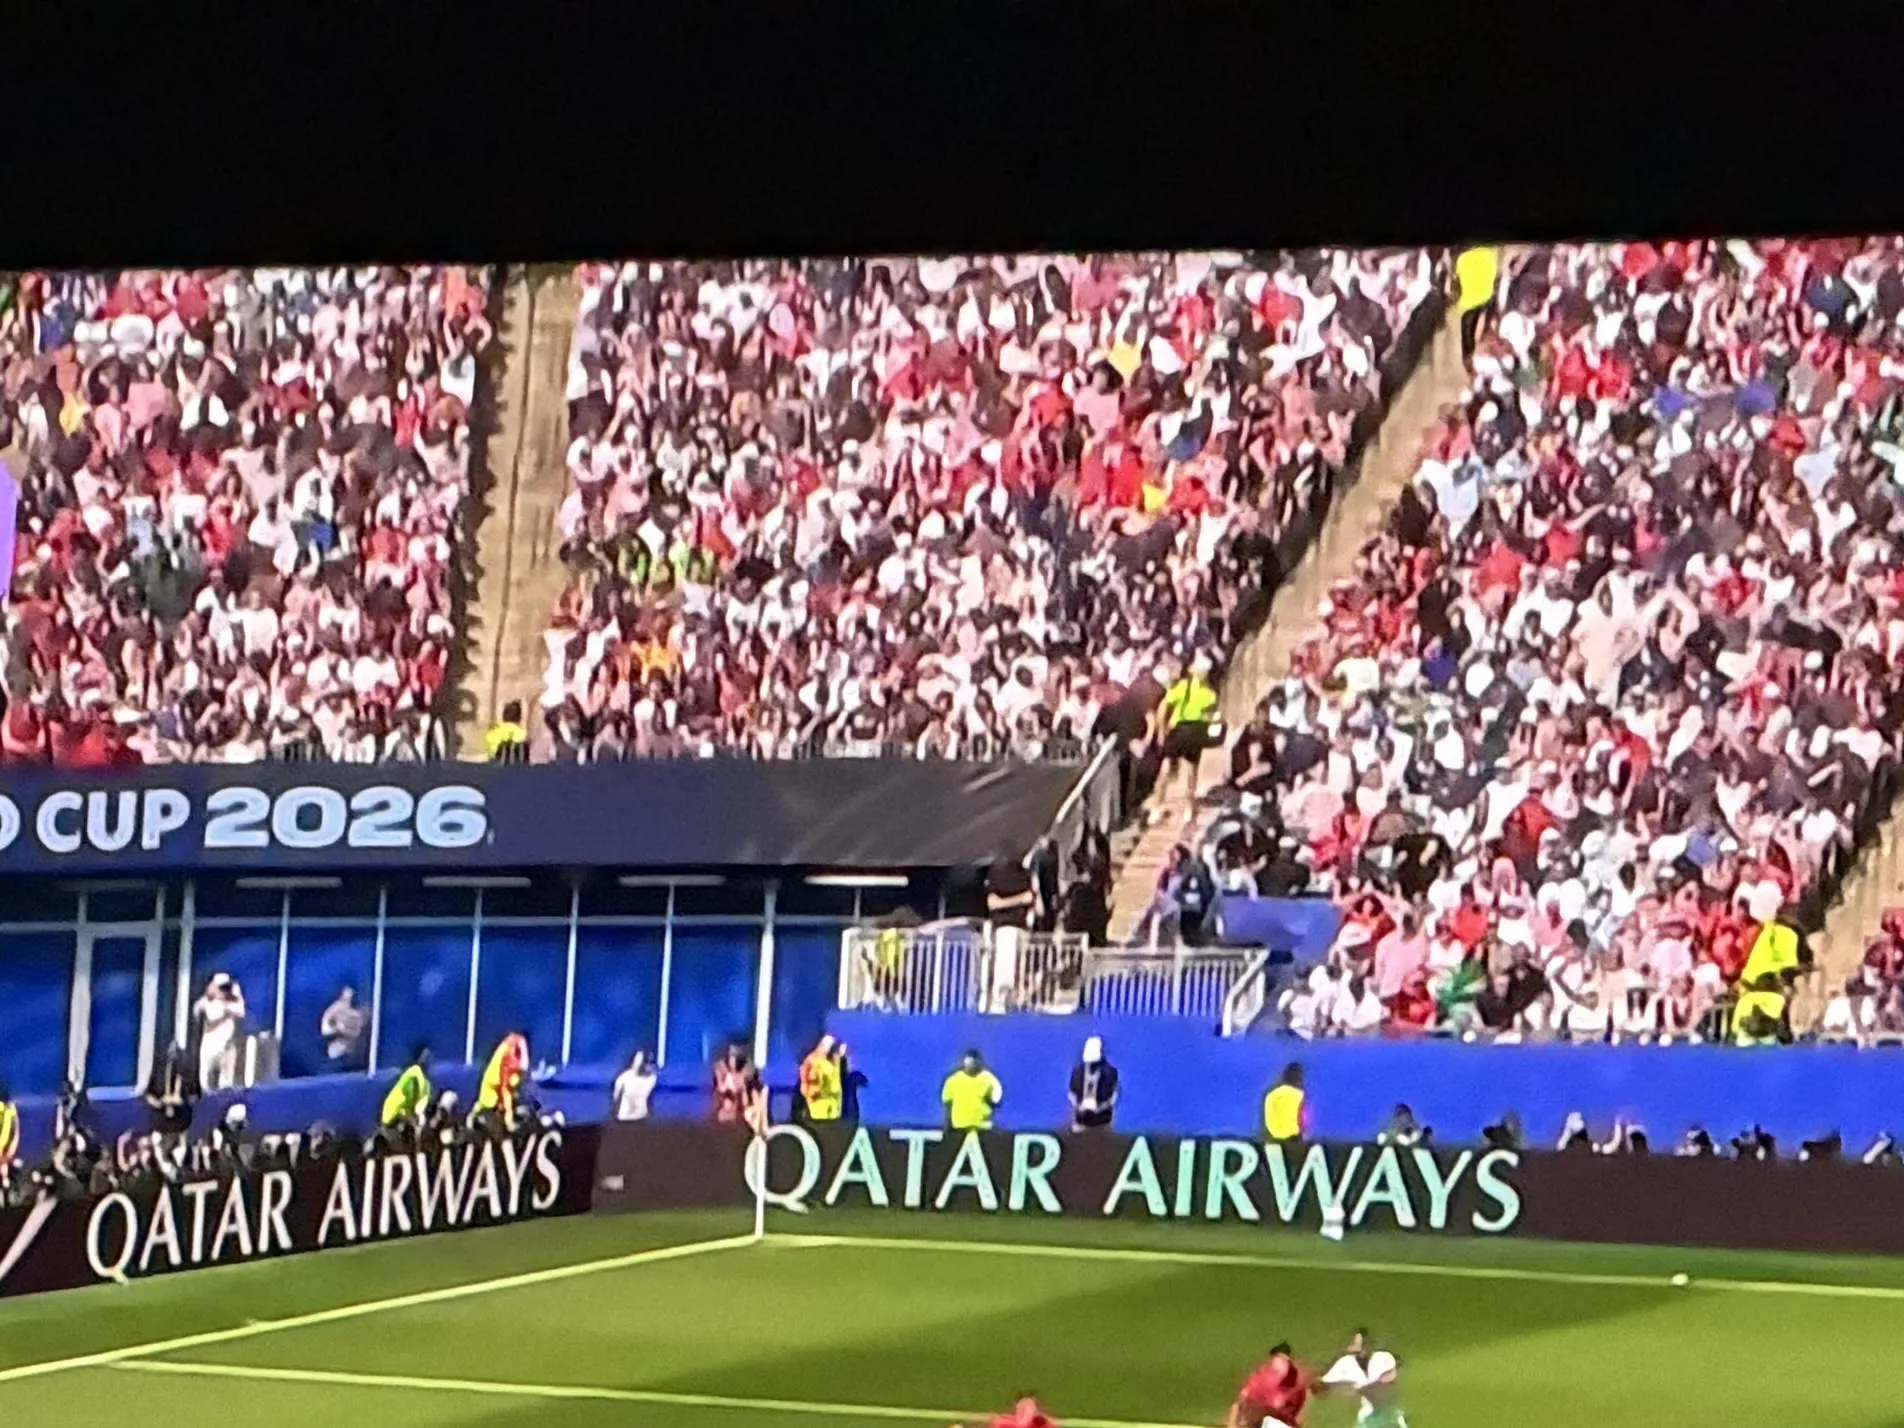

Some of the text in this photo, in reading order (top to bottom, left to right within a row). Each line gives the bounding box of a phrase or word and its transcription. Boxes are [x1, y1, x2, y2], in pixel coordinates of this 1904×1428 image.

[36, 788, 190, 853] CUP
[204, 785, 487, 848] 2026
[86, 1130, 563, 1286] QATAR AIRWAYS
[743, 1124, 1521, 1232] QATAR AIRWAYS
